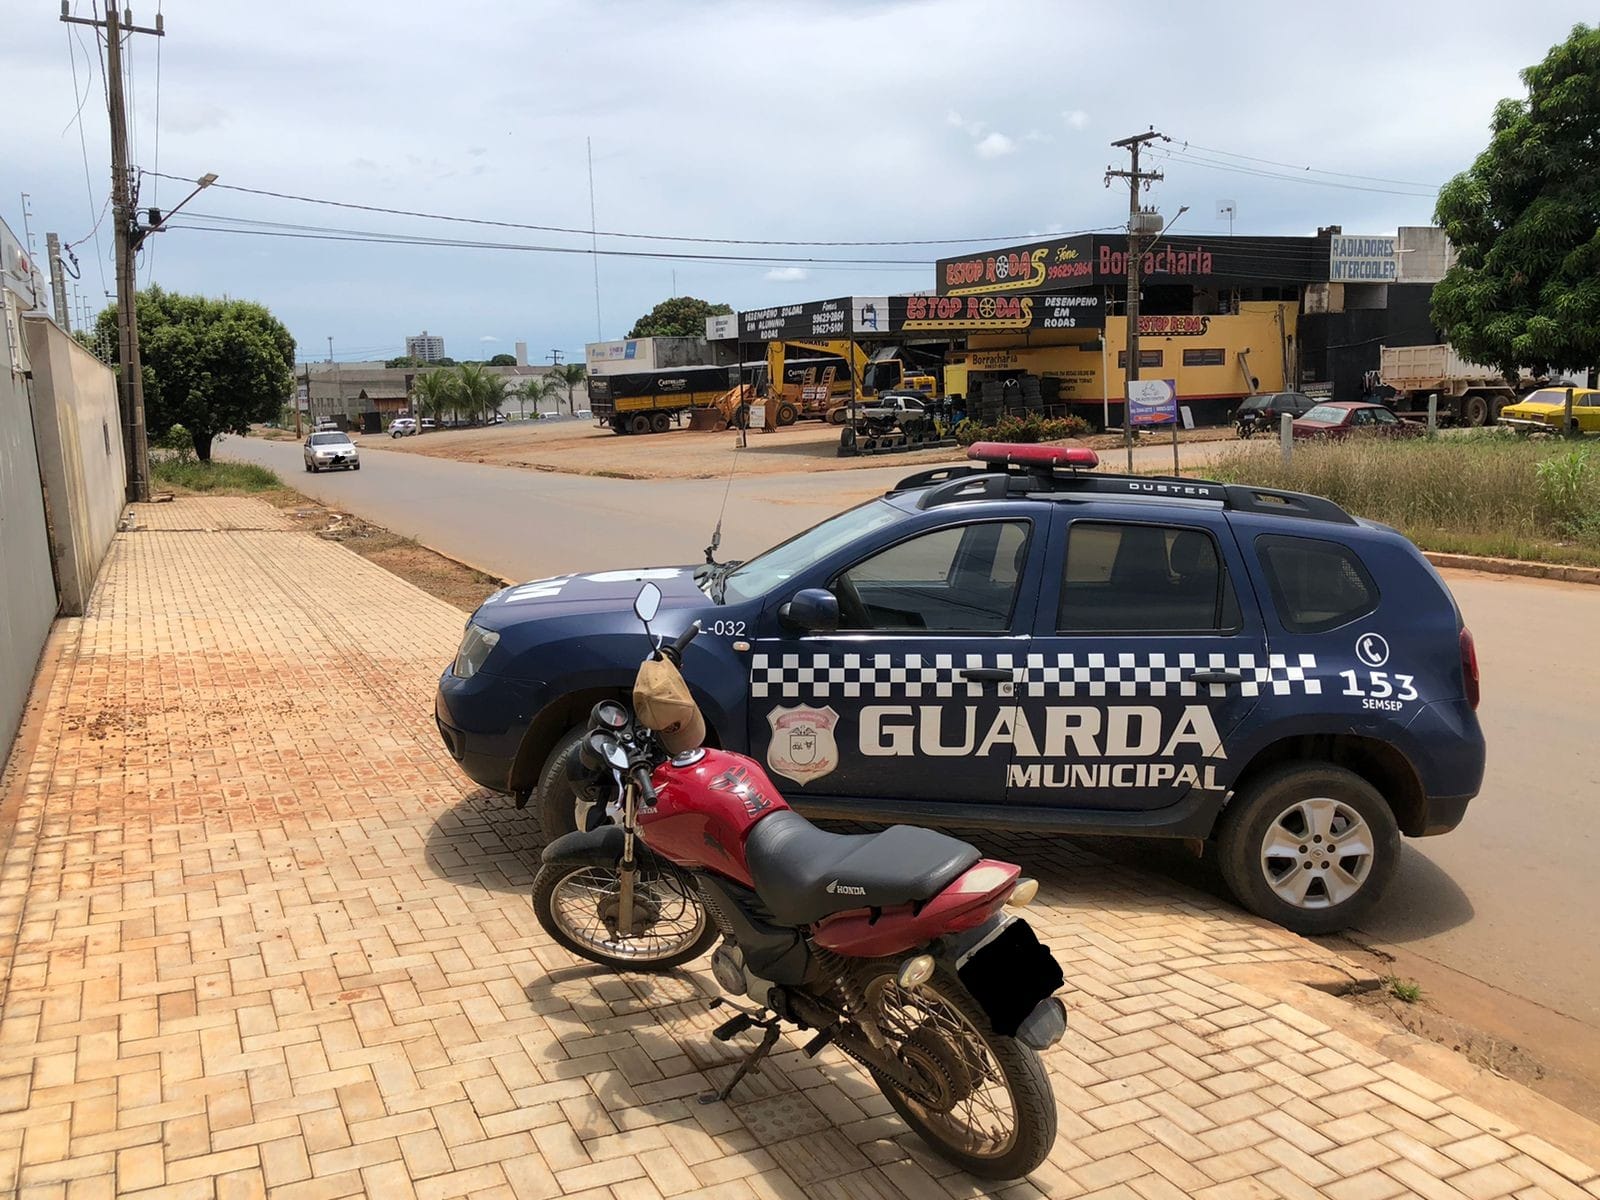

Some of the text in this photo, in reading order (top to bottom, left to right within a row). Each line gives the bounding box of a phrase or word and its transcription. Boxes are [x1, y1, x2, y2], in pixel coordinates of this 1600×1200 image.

[1055, 244, 1080, 264] Fone
[1332, 239, 1394, 257] RADIADORES
[1100, 244, 1213, 276] Boracharia
[946, 259, 984, 286] ESTOP
[1331, 260, 1396, 279] INTERCOOLER
[906, 296, 963, 320] ESTOP
[1045, 297, 1098, 307] DESEMPENO
[1054, 308, 1070, 317] EM
[747, 322, 756, 332] EM
[1044, 318, 1076, 328] RODAS
[1129, 483, 1209, 495] DUSTER
[1339, 669, 1418, 701] 153
[1362, 698, 1403, 711] SEMSEP
[858, 704, 1228, 759] GUARDA
[1006, 763, 1226, 791] MUNICIPAL
[836, 885, 866, 896] HONDA
